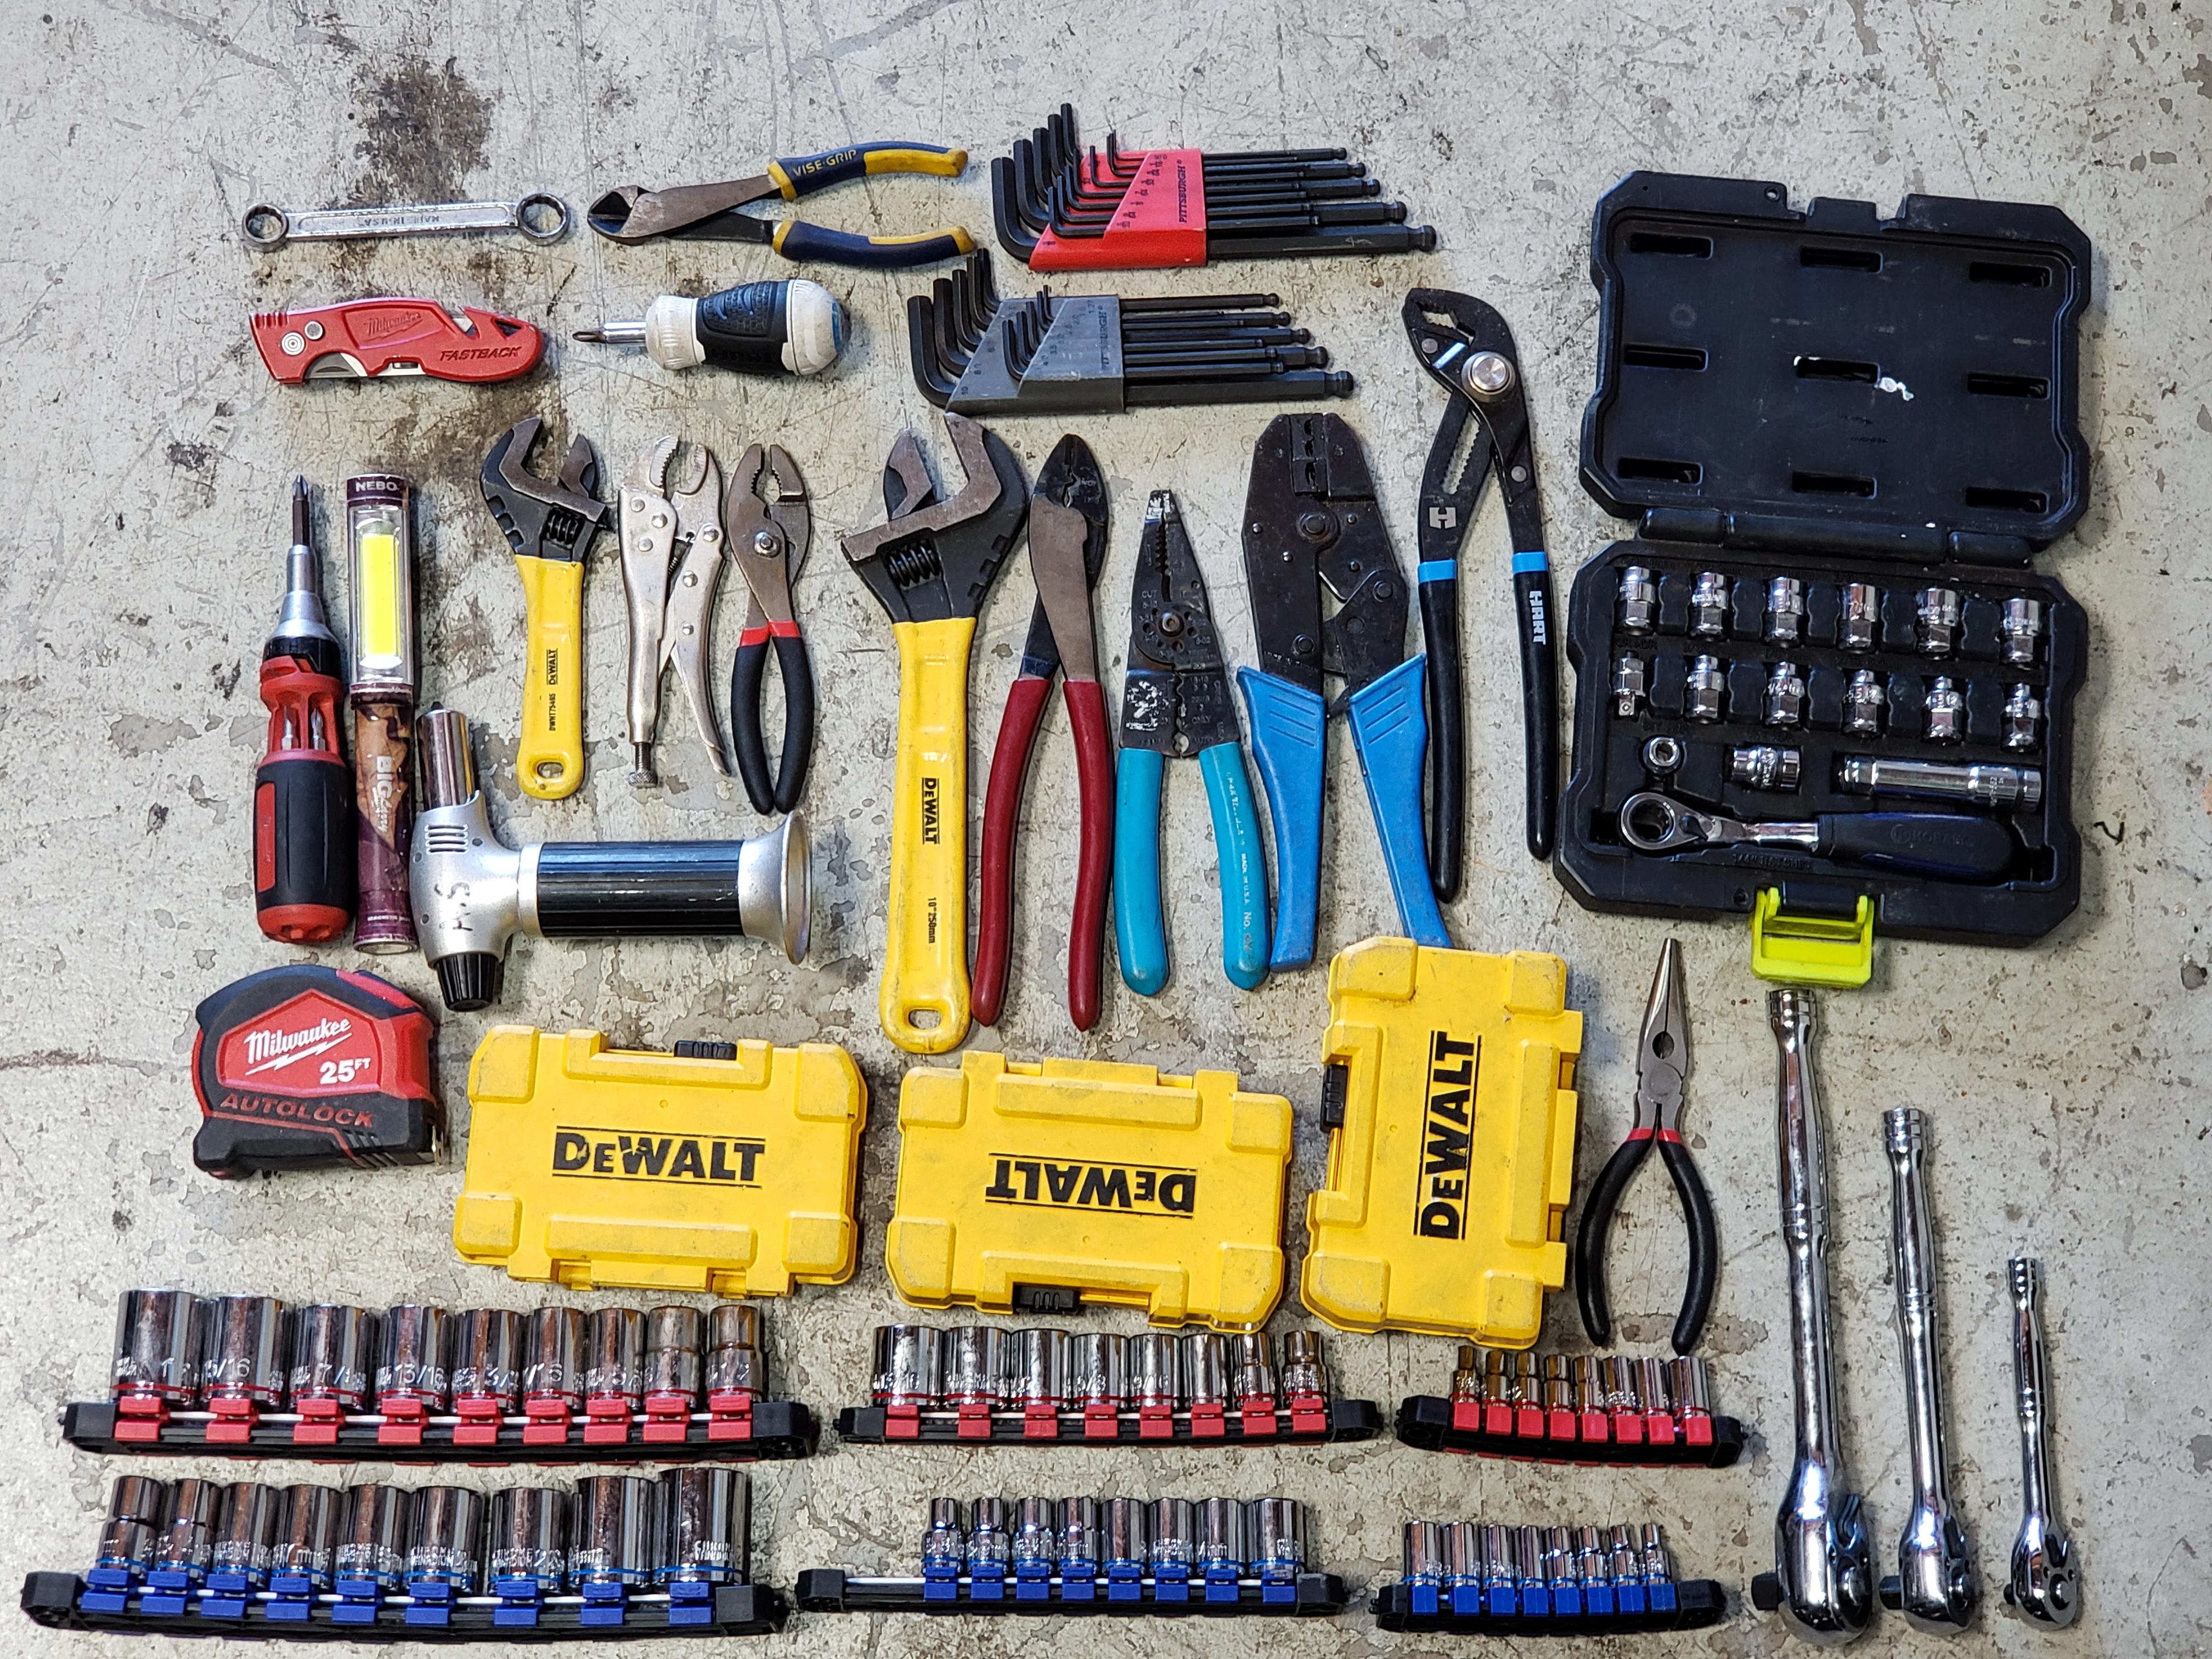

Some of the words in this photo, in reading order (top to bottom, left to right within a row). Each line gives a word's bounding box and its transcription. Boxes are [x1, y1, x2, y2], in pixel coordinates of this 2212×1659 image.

[1177, 166, 1187, 223] PITTSBURGH
[439, 346, 522, 361] FASTBACK
[356, 481, 398, 492] NEBO
[1529, 590, 1547, 645] HART
[376, 755, 393, 799] BIG
[244, 1018, 352, 1064] Milwaukee
[220, 1093, 376, 1129] AUTOLOCK
